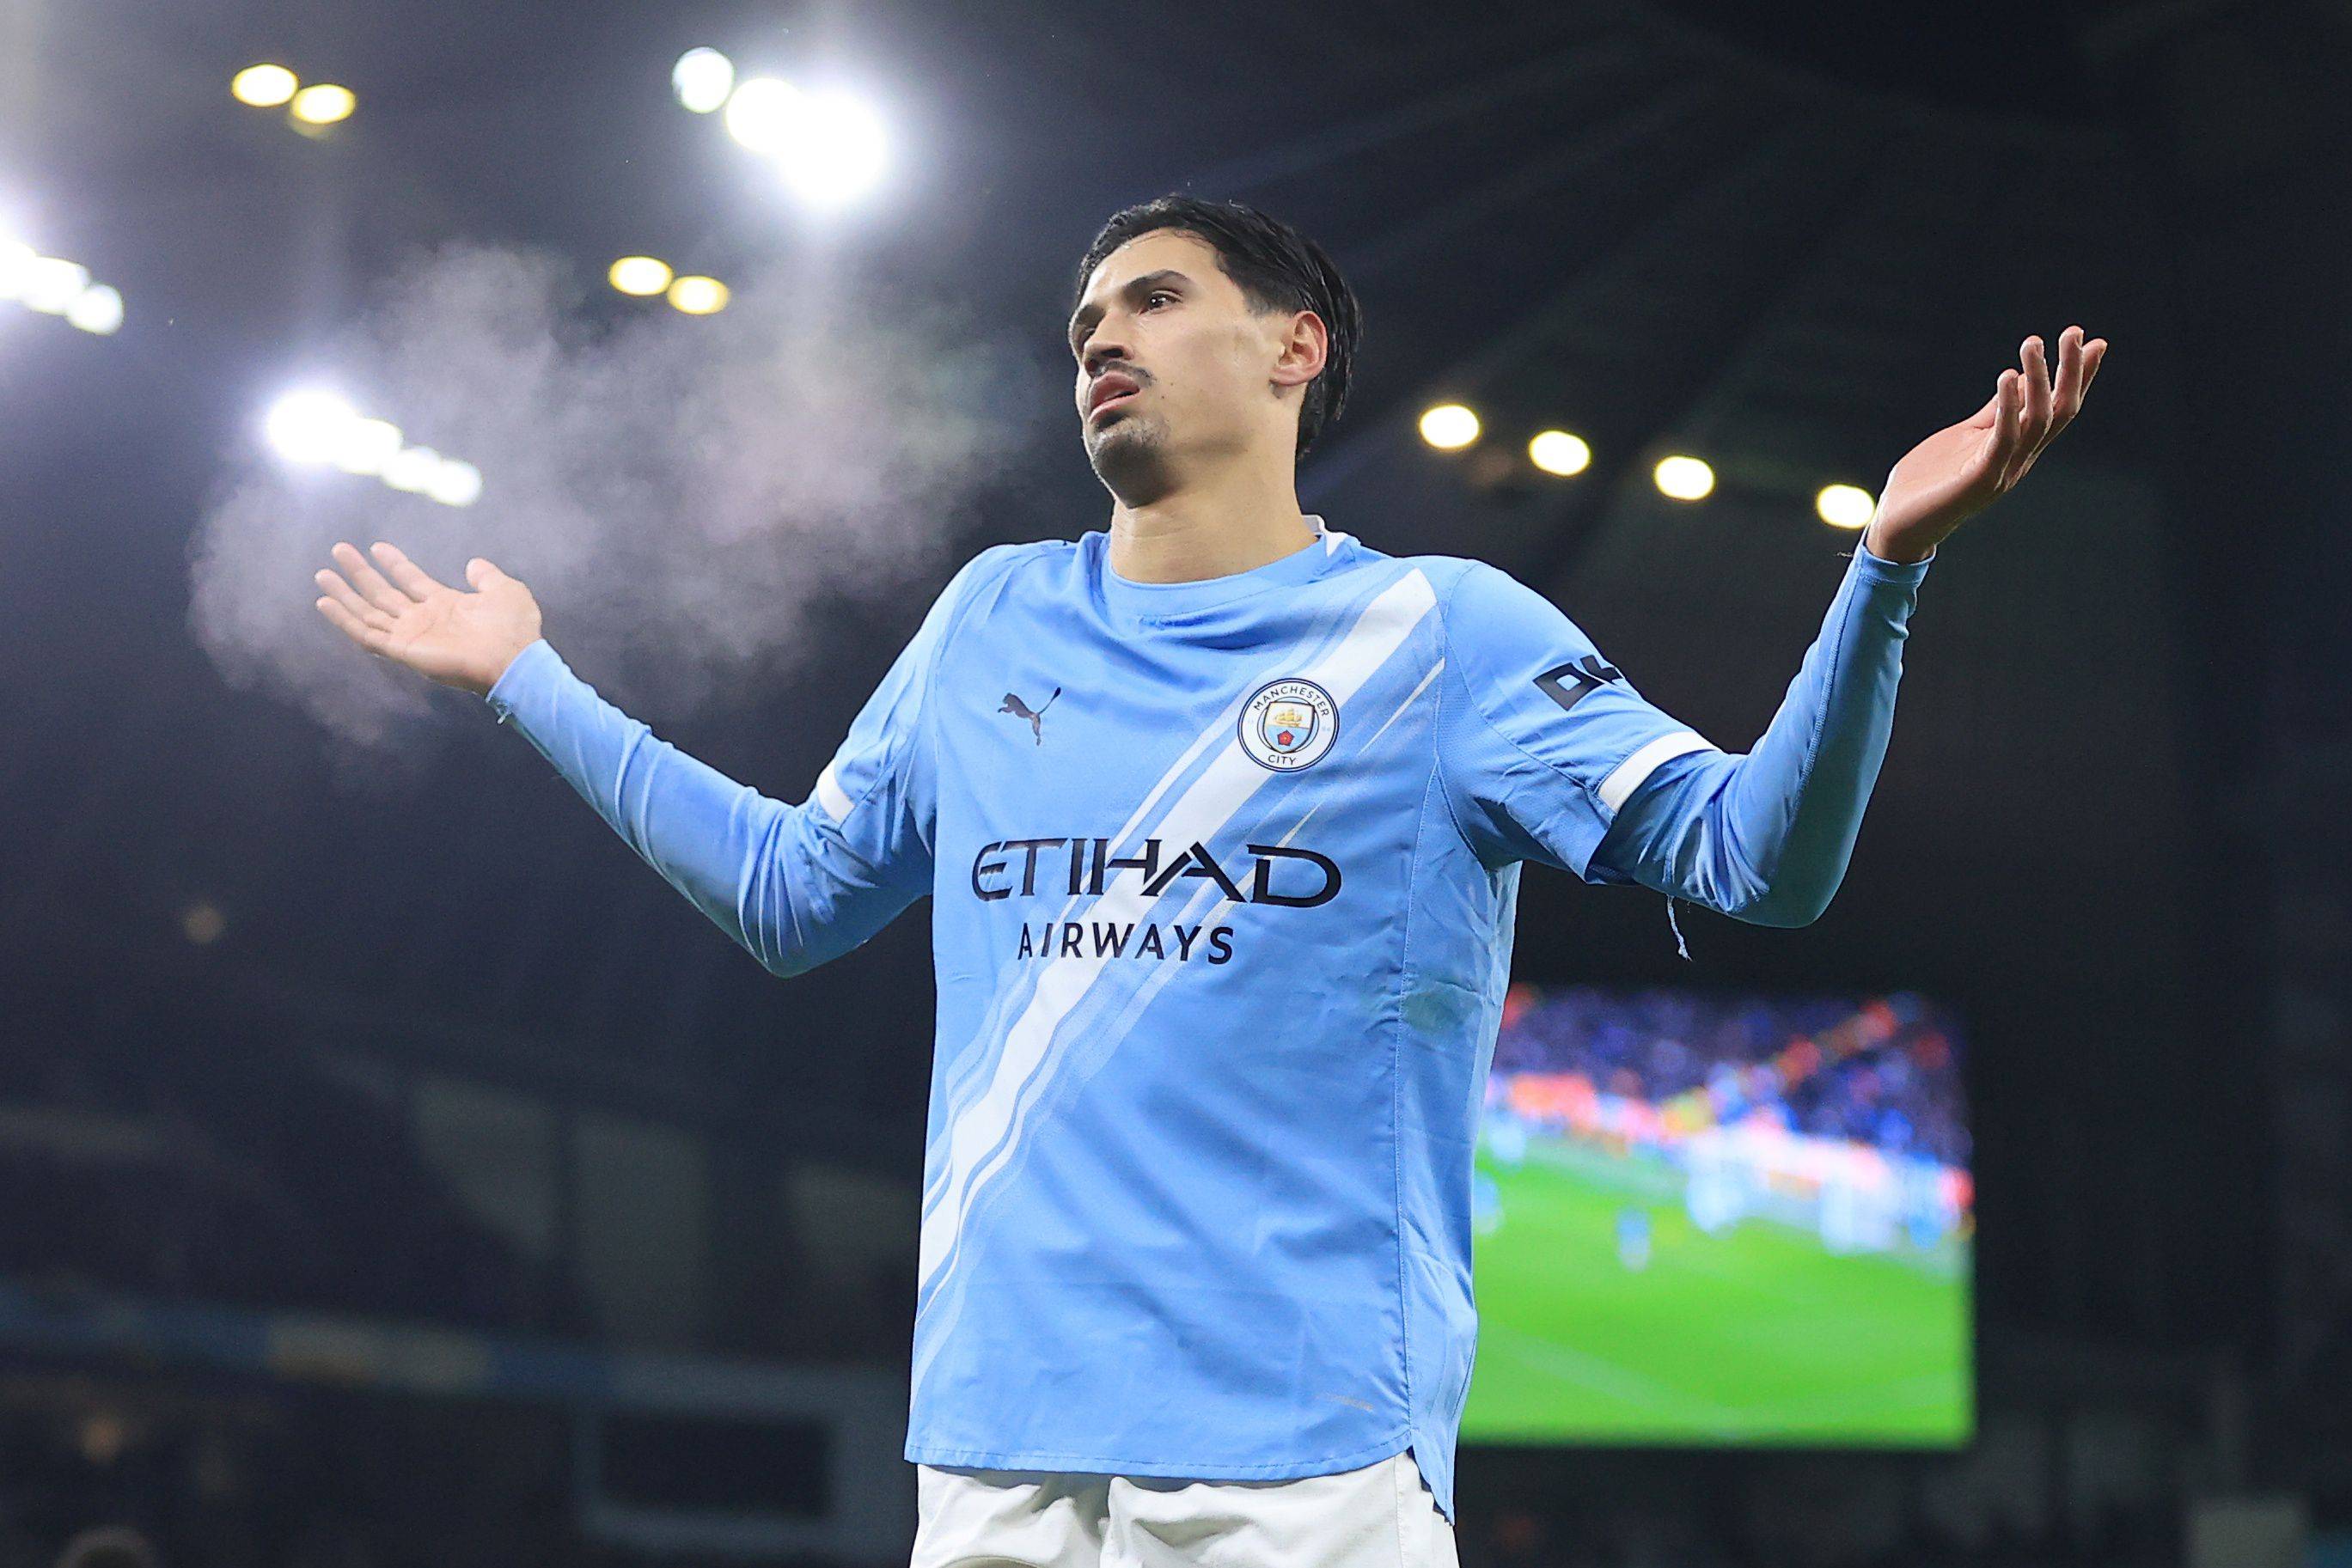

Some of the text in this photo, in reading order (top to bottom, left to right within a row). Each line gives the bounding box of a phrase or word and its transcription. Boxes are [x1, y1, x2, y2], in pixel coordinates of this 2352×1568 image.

[1254, 686, 1329, 717] MANCHESTER
[1268, 754, 1297, 766] CITY
[972, 838, 1342, 908] ETIHAD
[1017, 922, 1234, 965] AIRWAYS
